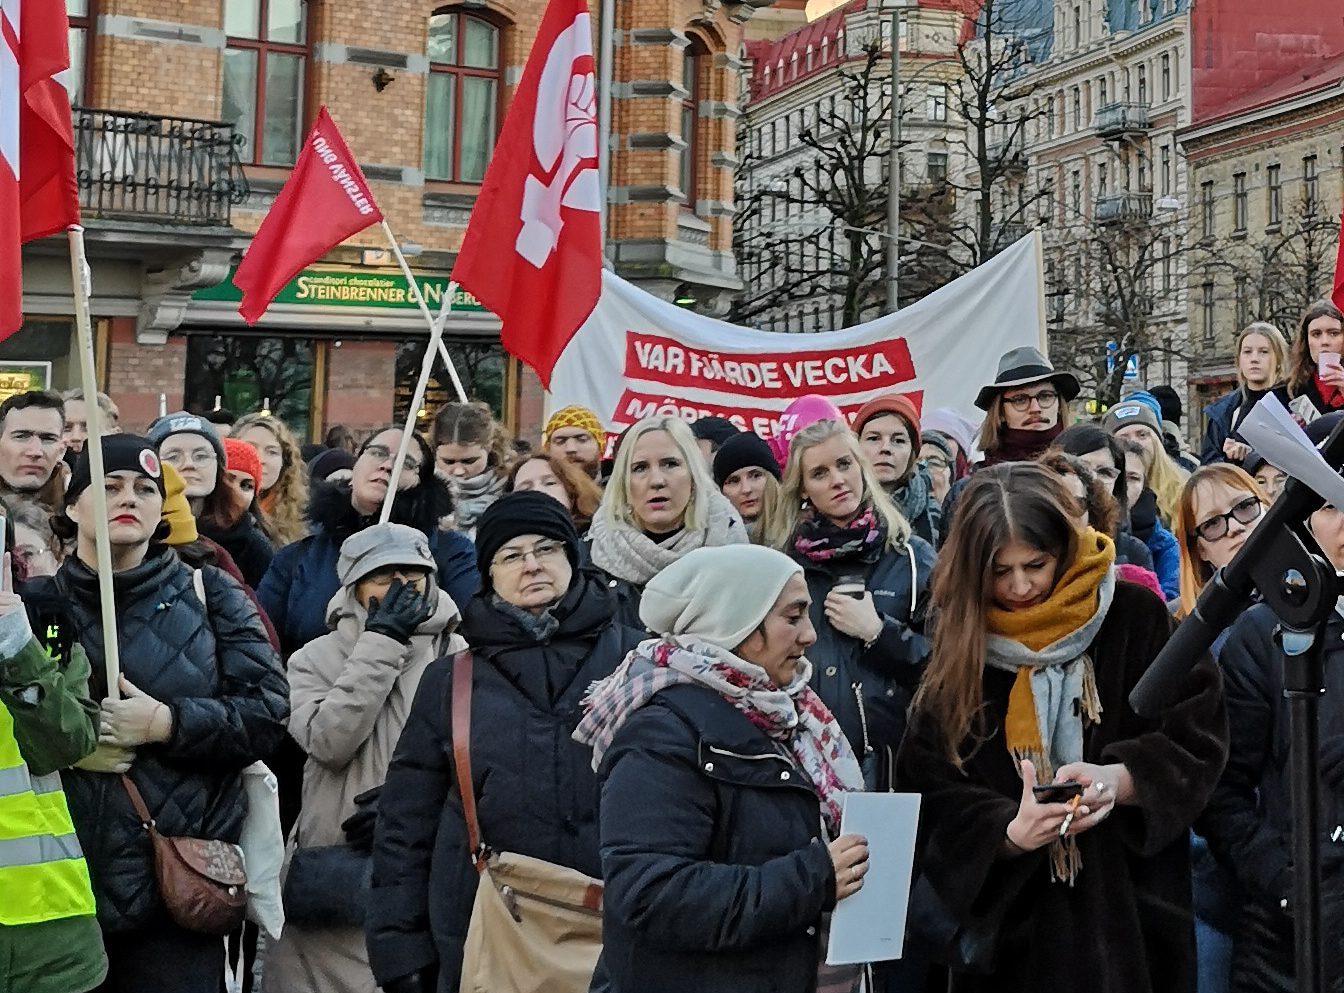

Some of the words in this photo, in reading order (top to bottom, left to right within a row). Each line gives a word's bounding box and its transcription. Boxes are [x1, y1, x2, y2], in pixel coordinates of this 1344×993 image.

[423, 282, 483, 306] NBER
[634, 340, 686, 375] VAR
[687, 351, 782, 389] FJÄRDE
[782, 352, 896, 389] VECKA
[625, 398, 749, 433] MÖRS
